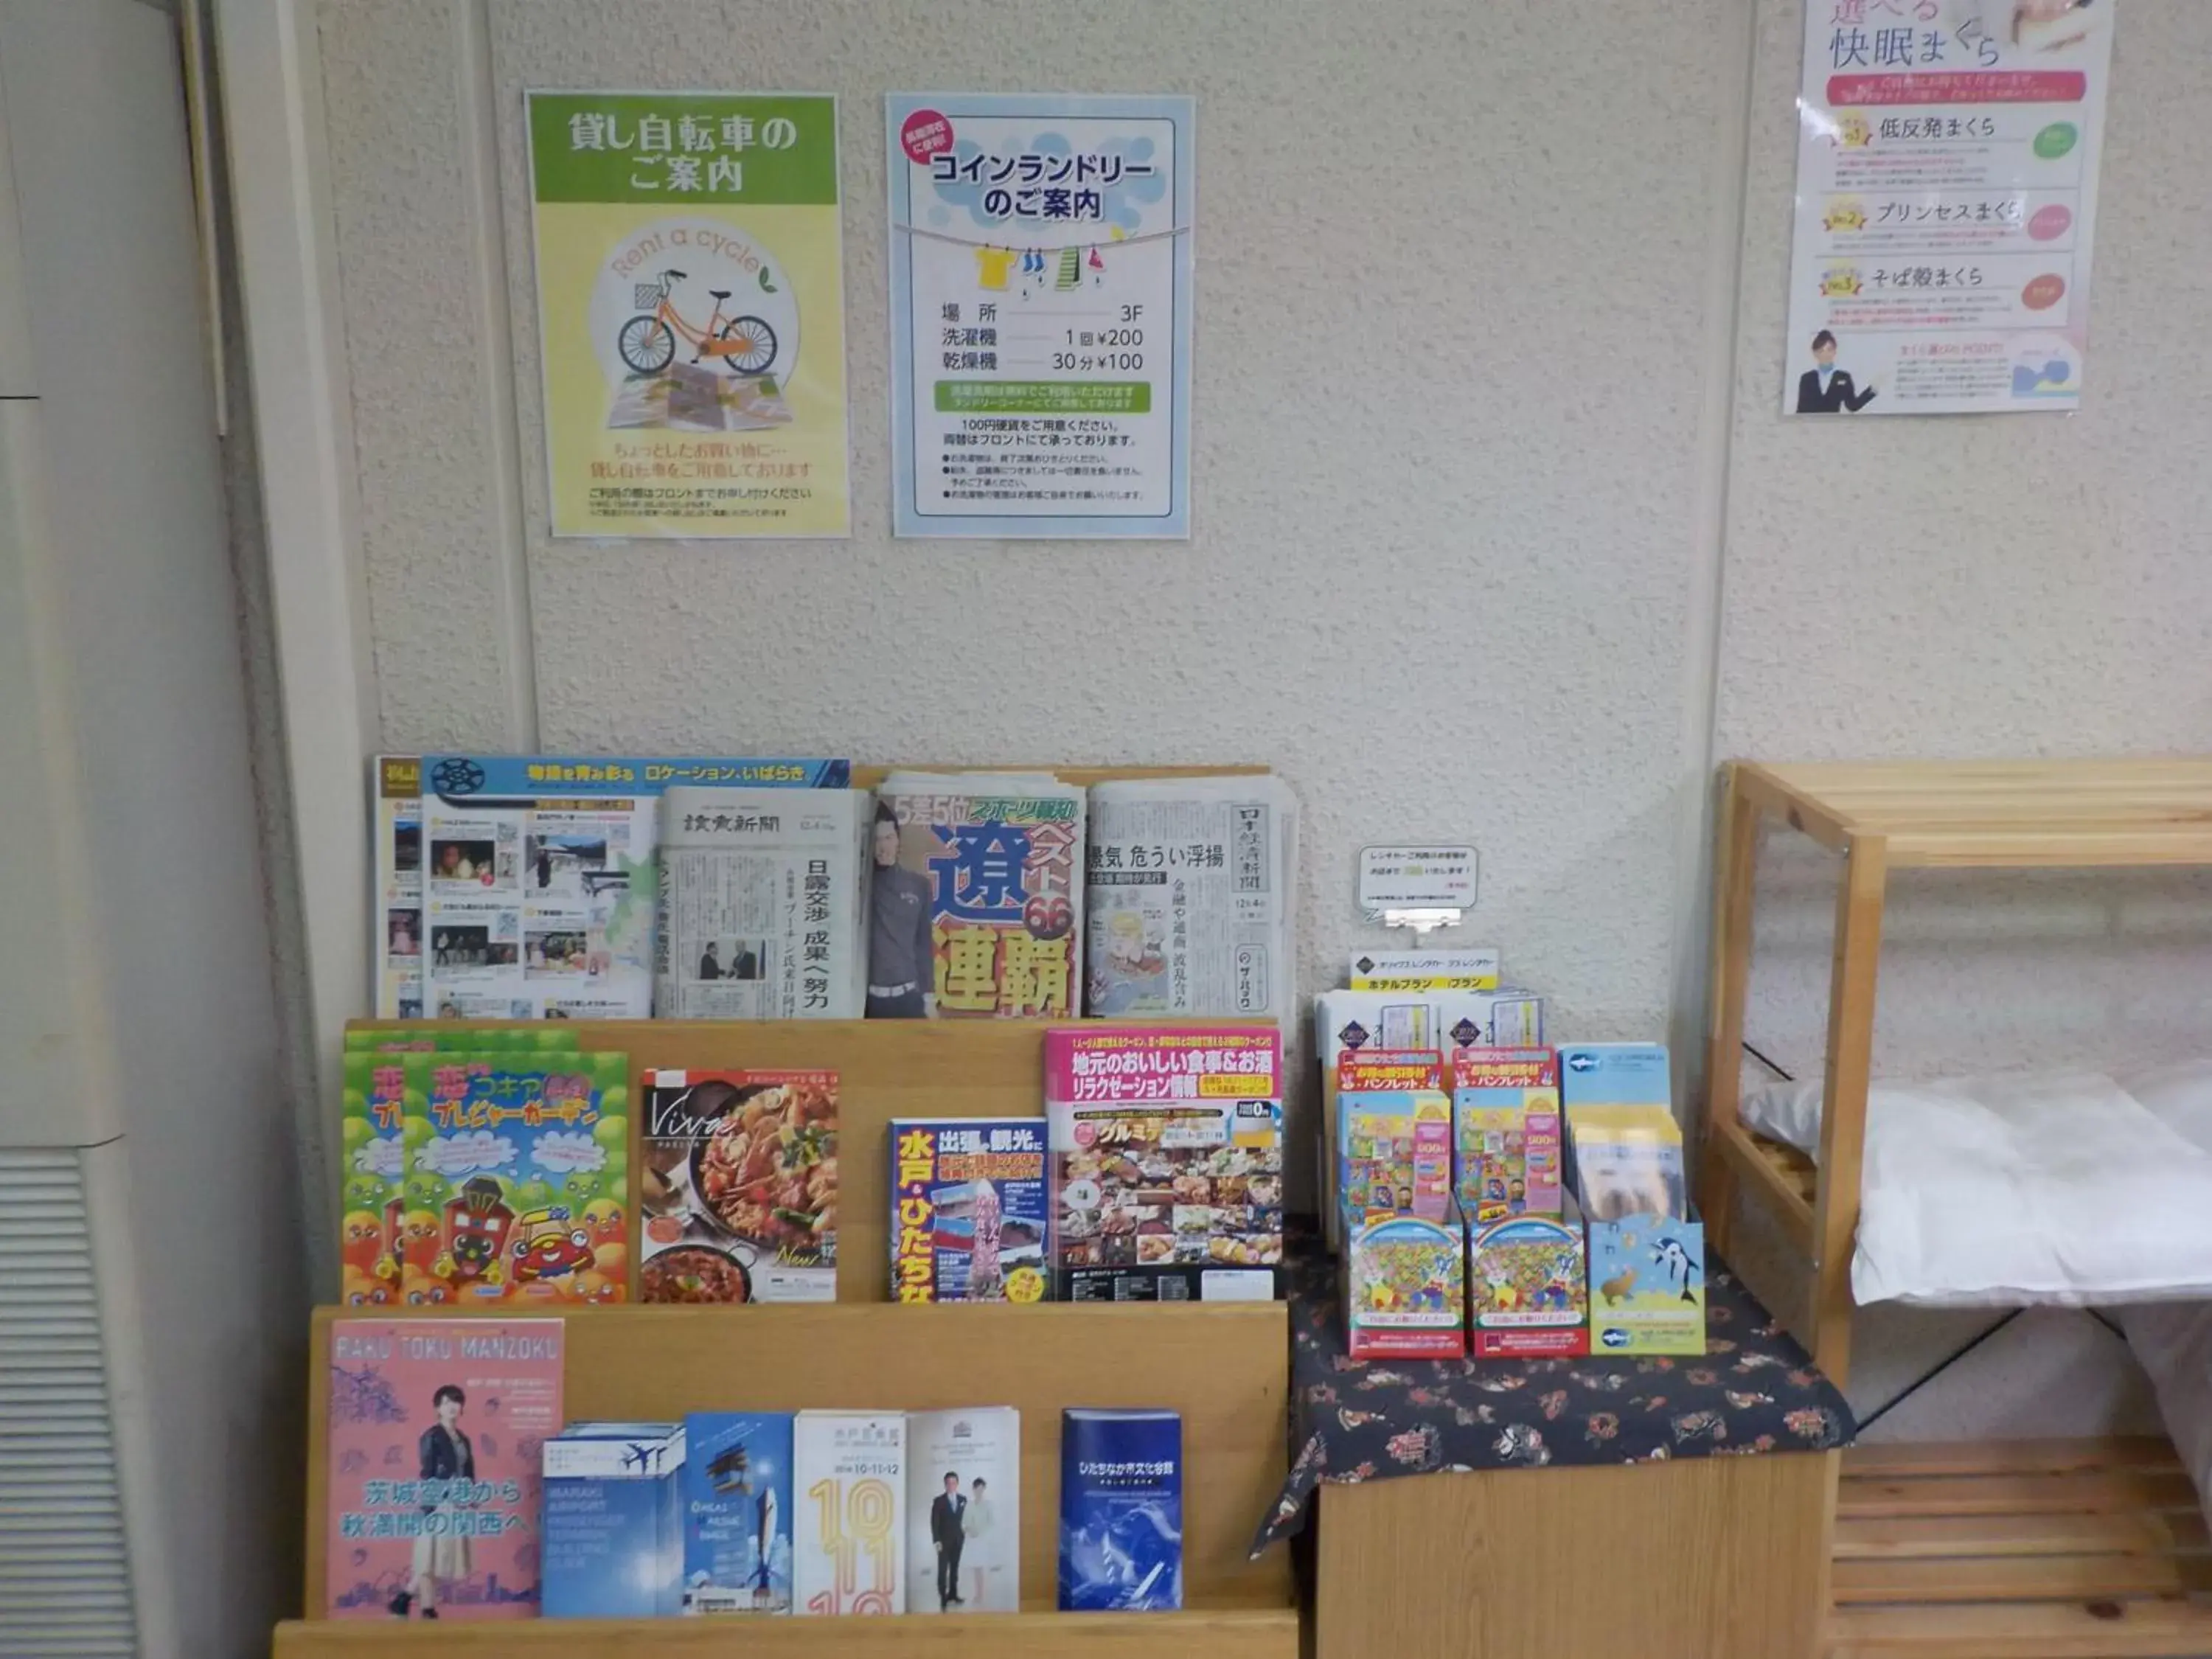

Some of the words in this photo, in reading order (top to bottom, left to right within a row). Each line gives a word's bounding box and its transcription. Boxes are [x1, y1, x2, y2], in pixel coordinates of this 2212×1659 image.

[1829, 20, 1999, 68] 快眠まくら
[568, 113, 797, 151] 貸し自転車の
[1879, 116, 1995, 139] 低反発まくら
[630, 153, 743, 192] ご案内
[933, 155, 1152, 182] コインランドリー
[984, 188, 1101, 219] のご案内
[1877, 201, 2022, 222] プリンセスまくら
[611, 232, 663, 279] Rent
[696, 229, 759, 274] cycle
[1871, 267, 1983, 288] そば殻まくら
[1120, 305, 1143, 322] 3F
[942, 328, 998, 347] 洗濯機
[942, 352, 998, 370] 乾燥機
[1130, 845, 1224, 869] 危うい浮揚
[1239, 809, 1262, 890] 日本経済新聞
[928, 821, 1032, 923] 遼
[1368, 978, 1433, 990] ホテルプラン
[1072, 1049, 1273, 1075] 地元のおいしい食事&お酒
[474, 1077, 542, 1099] コキア
[1073, 1074, 1198, 1099] リラクゼーション情報
[1363, 1077, 1419, 1090] パンフレット
[1477, 1076, 1531, 1087] パンフレット
[651, 1087, 737, 1136] Viva
[336, 1336, 391, 1360] RAKU
[402, 1336, 451, 1360] TOKU
[460, 1336, 558, 1360] MANZOKU
[364, 1477, 522, 1505] 茨城空港から
[340, 1511, 530, 1537] 秋満開の関西へ
